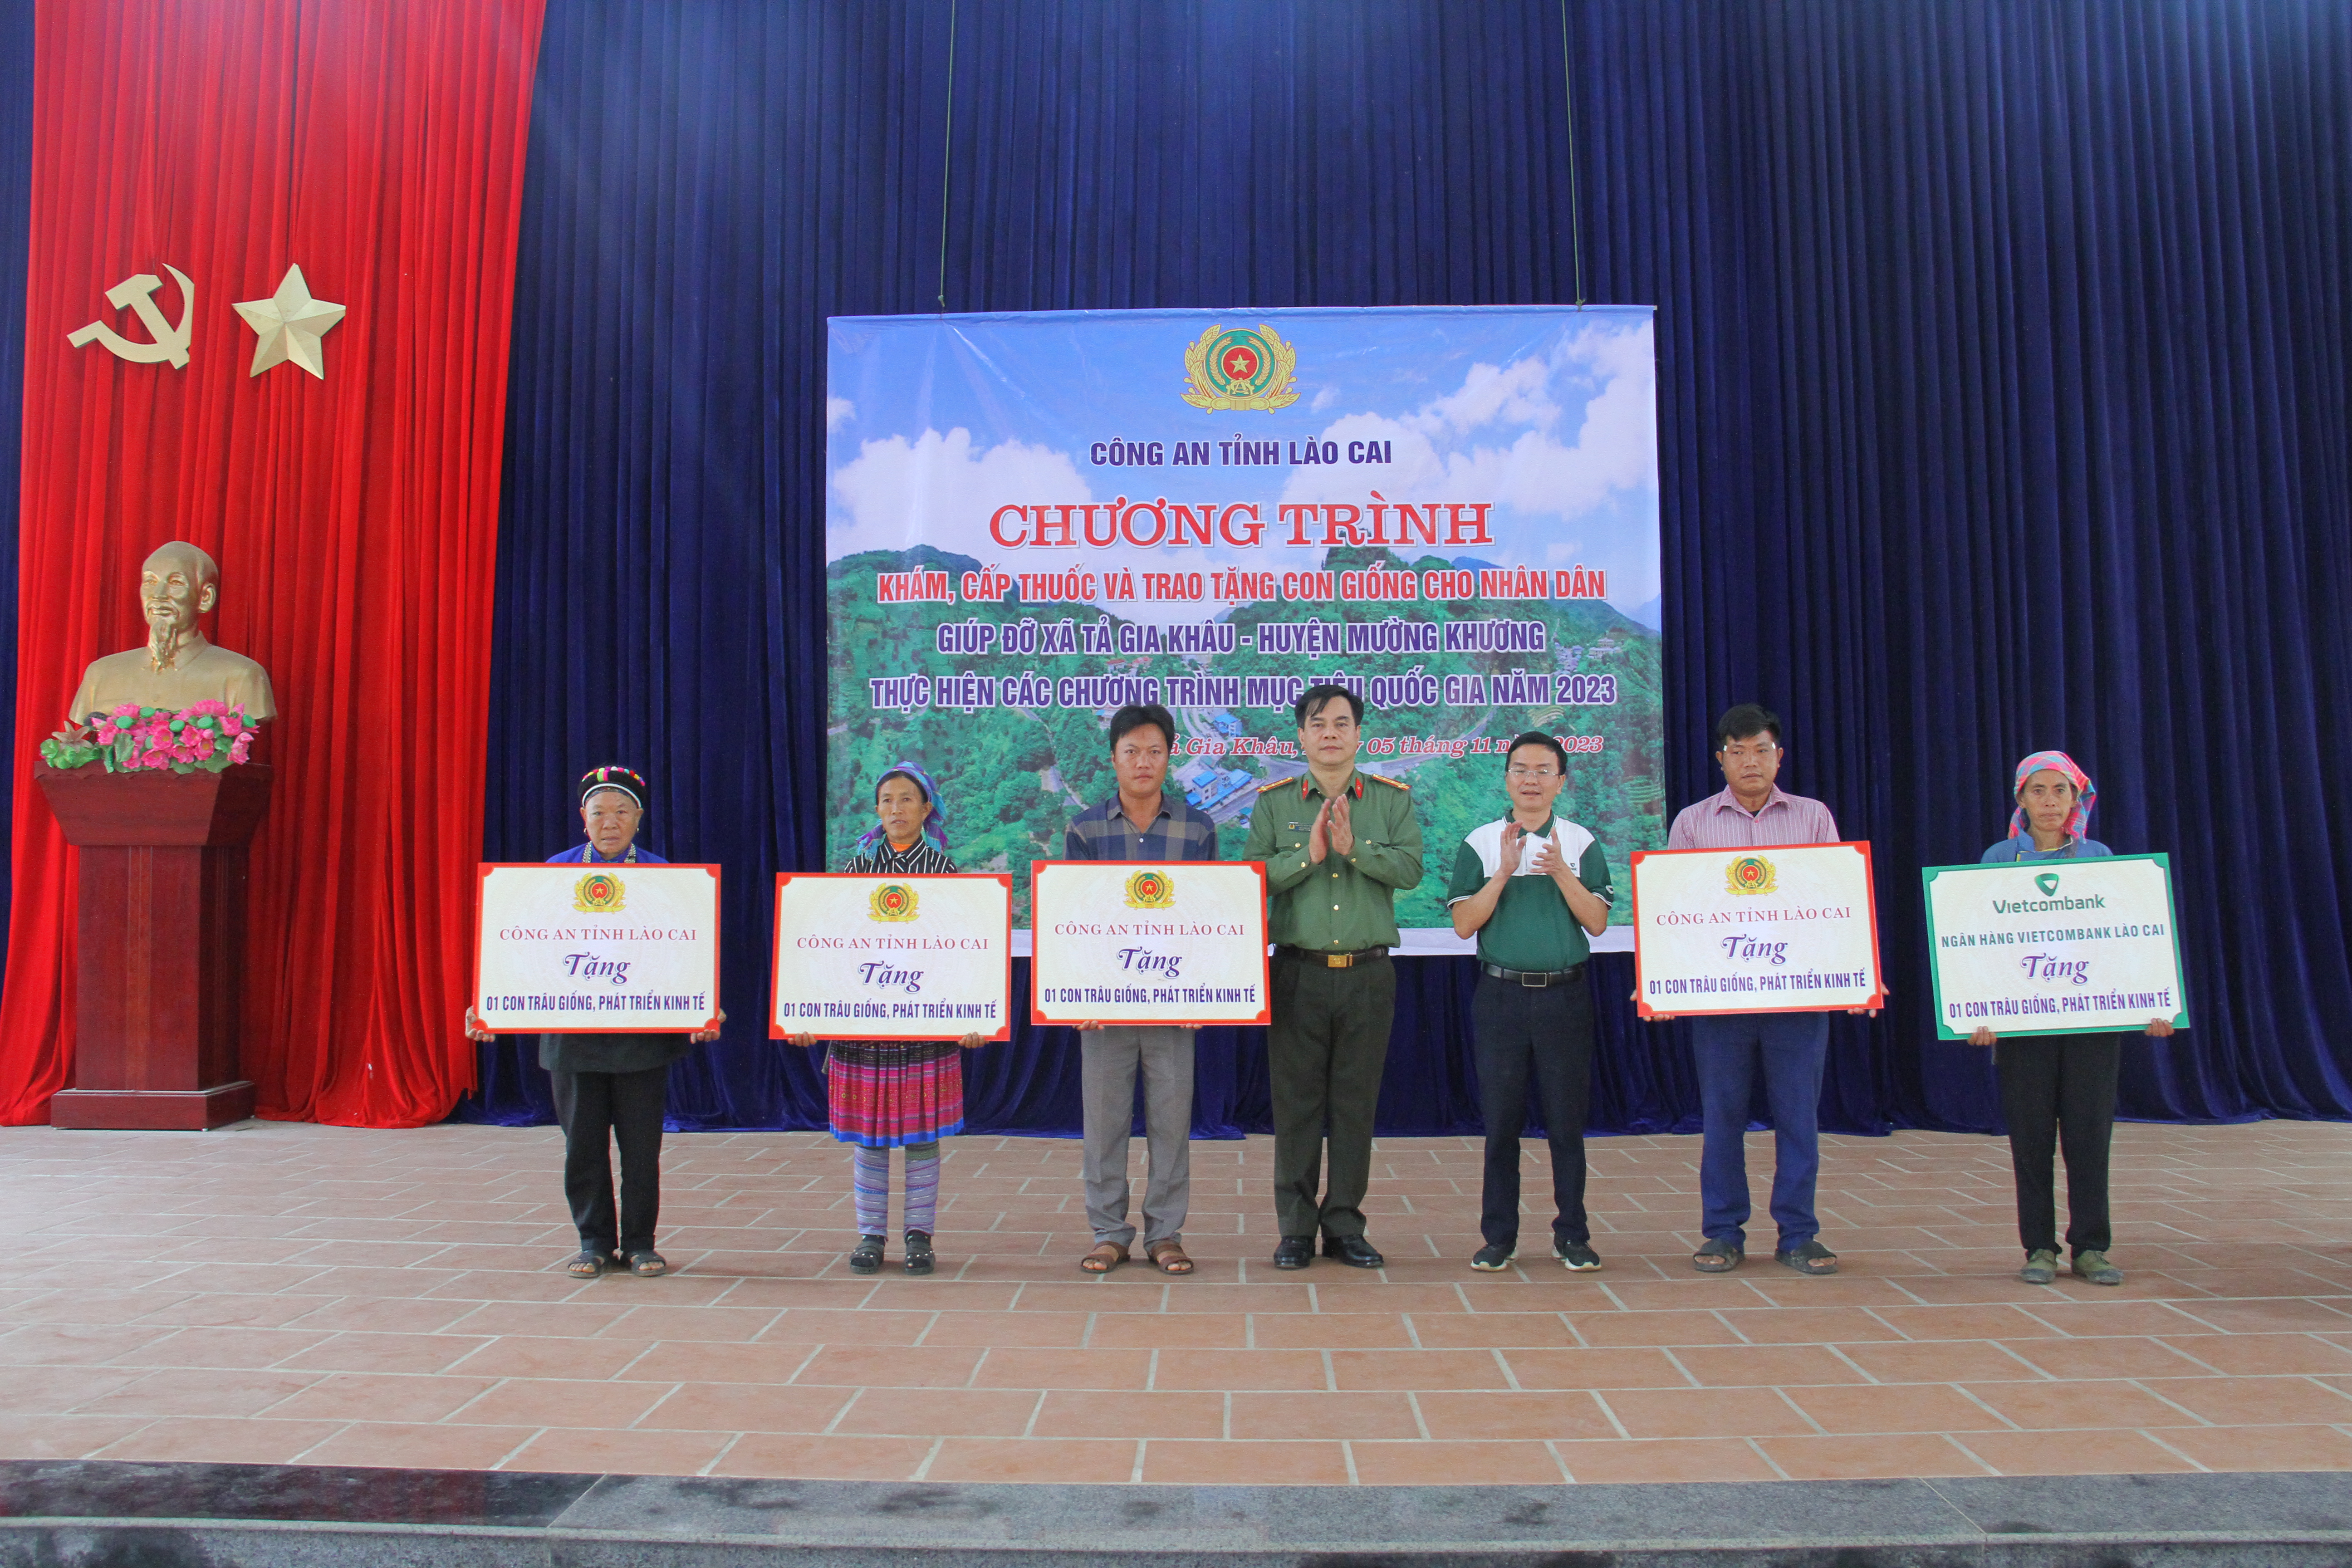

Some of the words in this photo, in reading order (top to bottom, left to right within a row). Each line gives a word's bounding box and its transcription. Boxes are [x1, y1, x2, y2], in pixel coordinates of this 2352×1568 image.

[1091, 437, 1163, 466] CÔNG
[1172, 442, 1209, 465] AN
[1219, 433, 1279, 465] TỈNH
[1289, 436, 1338, 465] LÀO
[1348, 441, 1391, 464] CAI
[990, 497, 1264, 547] CHƯƠNG
[1280, 491, 1491, 545] TRÌNH
[880, 566, 955, 603] KHÁM,
[964, 564, 1010, 600] CẤP
[1019, 564, 1095, 600] THUỐC
[1105, 568, 1134, 599] VÀ
[1143, 573, 1202, 599] TRAO
[1211, 568, 1274, 605] TẶNG
[1284, 572, 1332, 599] CON
[1343, 563, 1415, 599] GIỐNG
[1425, 572, 1471, 599] CHO
[1482, 566, 1546, 597] NHÂN
[1556, 565, 1604, 597] DÂN
[939, 620, 994, 652] GIÚP
[1002, 620, 1035, 653] ĐỠ
[1043, 620, 1074, 652] XÃ
[1083, 614, 1112, 652] TẢ
[1120, 625, 1160, 652] GIA
[1169, 619, 1233, 652] KHÂU
[1259, 619, 1338, 658] HUYỆN
[1348, 618, 1437, 652] MƯỜNG
[1446, 621, 1544, 650] KHƯƠNG
[871, 675, 928, 711] THỰC
[938, 673, 993, 711] HIỆN
[1003, 673, 1050, 706] CÁC
[1059, 676, 1158, 706] CHƯƠNG
[1166, 672, 1238, 706] TRÌNH
[1248, 678, 1302, 711] MỤC
[1372, 667, 1436, 708] QUỐC
[1446, 676, 1485, 704] GIA
[1493, 671, 1548, 703] NĂM
[1557, 676, 1615, 703] 2023
[1170, 734, 1180, 755] ả
[1187, 738, 1225, 755] Gia
[1230, 736, 1298, 758] Khâu,
[1367, 738, 1394, 754] 05
[1400, 735, 1466, 758] tháng
[1470, 738, 1490, 753] 11
[1656, 911, 1704, 926] CÔNG
[1708, 912, 1731, 924] AN
[1735, 906, 1779, 922] TỈNH
[1783, 905, 1817, 921] LÀO
[1822, 906, 1851, 919] CAI
[1992, 894, 2105, 914] Vietcombank
[500, 925, 549, 941] CÔNG
[553, 929, 577, 940] AN
[581, 924, 624, 940] TỈNH
[629, 925, 663, 941] LÀO
[668, 929, 696, 941] CAI
[797, 934, 844, 949] CÔNG
[848, 938, 872, 949] AN
[875, 934, 917, 949] TỈNH
[922, 935, 956, 950] LÀO
[960, 938, 988, 950] CAI
[1054, 921, 1102, 935] CÔNG
[1106, 924, 1128, 935] AN
[1132, 920, 1174, 935] TỈNH
[1179, 921, 1212, 936] LÀO
[1216, 924, 1244, 936] CAI
[1941, 932, 1976, 948] NGÂN
[1979, 931, 2015, 946] HÀNG
[2017, 926, 2112, 943] VIETCOMBANK
[2114, 923, 2139, 938] LÀO
[2142, 924, 2165, 936] CAI
[1116, 946, 1183, 980] Tặng
[1720, 933, 1788, 967] Tặng
[562, 951, 631, 986] Tặng
[858, 960, 925, 995] Tặng
[1649, 980, 1661, 995] 01
[1665, 979, 1687, 994] CON
[1689, 975, 1717, 993] TRÂU
[1720, 971, 1757, 993] GIỐNG,
[1759, 972, 1788, 991] PHÁT
[1789, 968, 1822, 990] TRIỂN
[1824, 972, 1851, 989] KINH
[1852, 967, 1867, 987] TẾ
[2019, 952, 2090, 986] Tặng
[486, 996, 499, 1011] 01
[502, 995, 525, 1011] CON
[527, 992, 556, 1011] TRÂU
[558, 990, 596, 1012] GIỐNG,
[598, 992, 627, 1010] PHÁT
[628, 989, 661, 1010] TRIỂN
[663, 995, 690, 1010] KINH
[692, 990, 706, 1011] TẾ
[784, 1002, 796, 1017] 01
[799, 1002, 821, 1018] CON
[823, 1000, 851, 1018] TRÂU
[853, 998, 890, 1020] GIỐNG,
[892, 1000, 920, 1019] PHÁT
[922, 997, 953, 1019] TRIỂN
[956, 1004, 982, 1019] KINH
[984, 999, 997, 1019] TẾ
[1044, 988, 1056, 1003] 01
[1060, 988, 1082, 1003] CON
[1084, 985, 1111, 1004] TRÂU
[1114, 983, 1150, 1005] GIỐNG,
[1153, 985, 1180, 1003] PHÁT
[1182, 982, 1213, 1003] TRIỂN
[1215, 988, 1241, 1003] KINH
[1243, 983, 1255, 1003] TẾ
[1949, 1003, 1962, 1019] 01
[1965, 1001, 1989, 1018] CON
[1989, 997, 2019, 1016] TRÂU
[2021, 993, 2060, 1014] GIỐNG,
[2062, 993, 2091, 1012] PHÁT
[2092, 988, 2127, 1011] TRIỂN
[2127, 992, 2156, 1009] KINH
[2156, 986, 2172, 1007] TẾ
